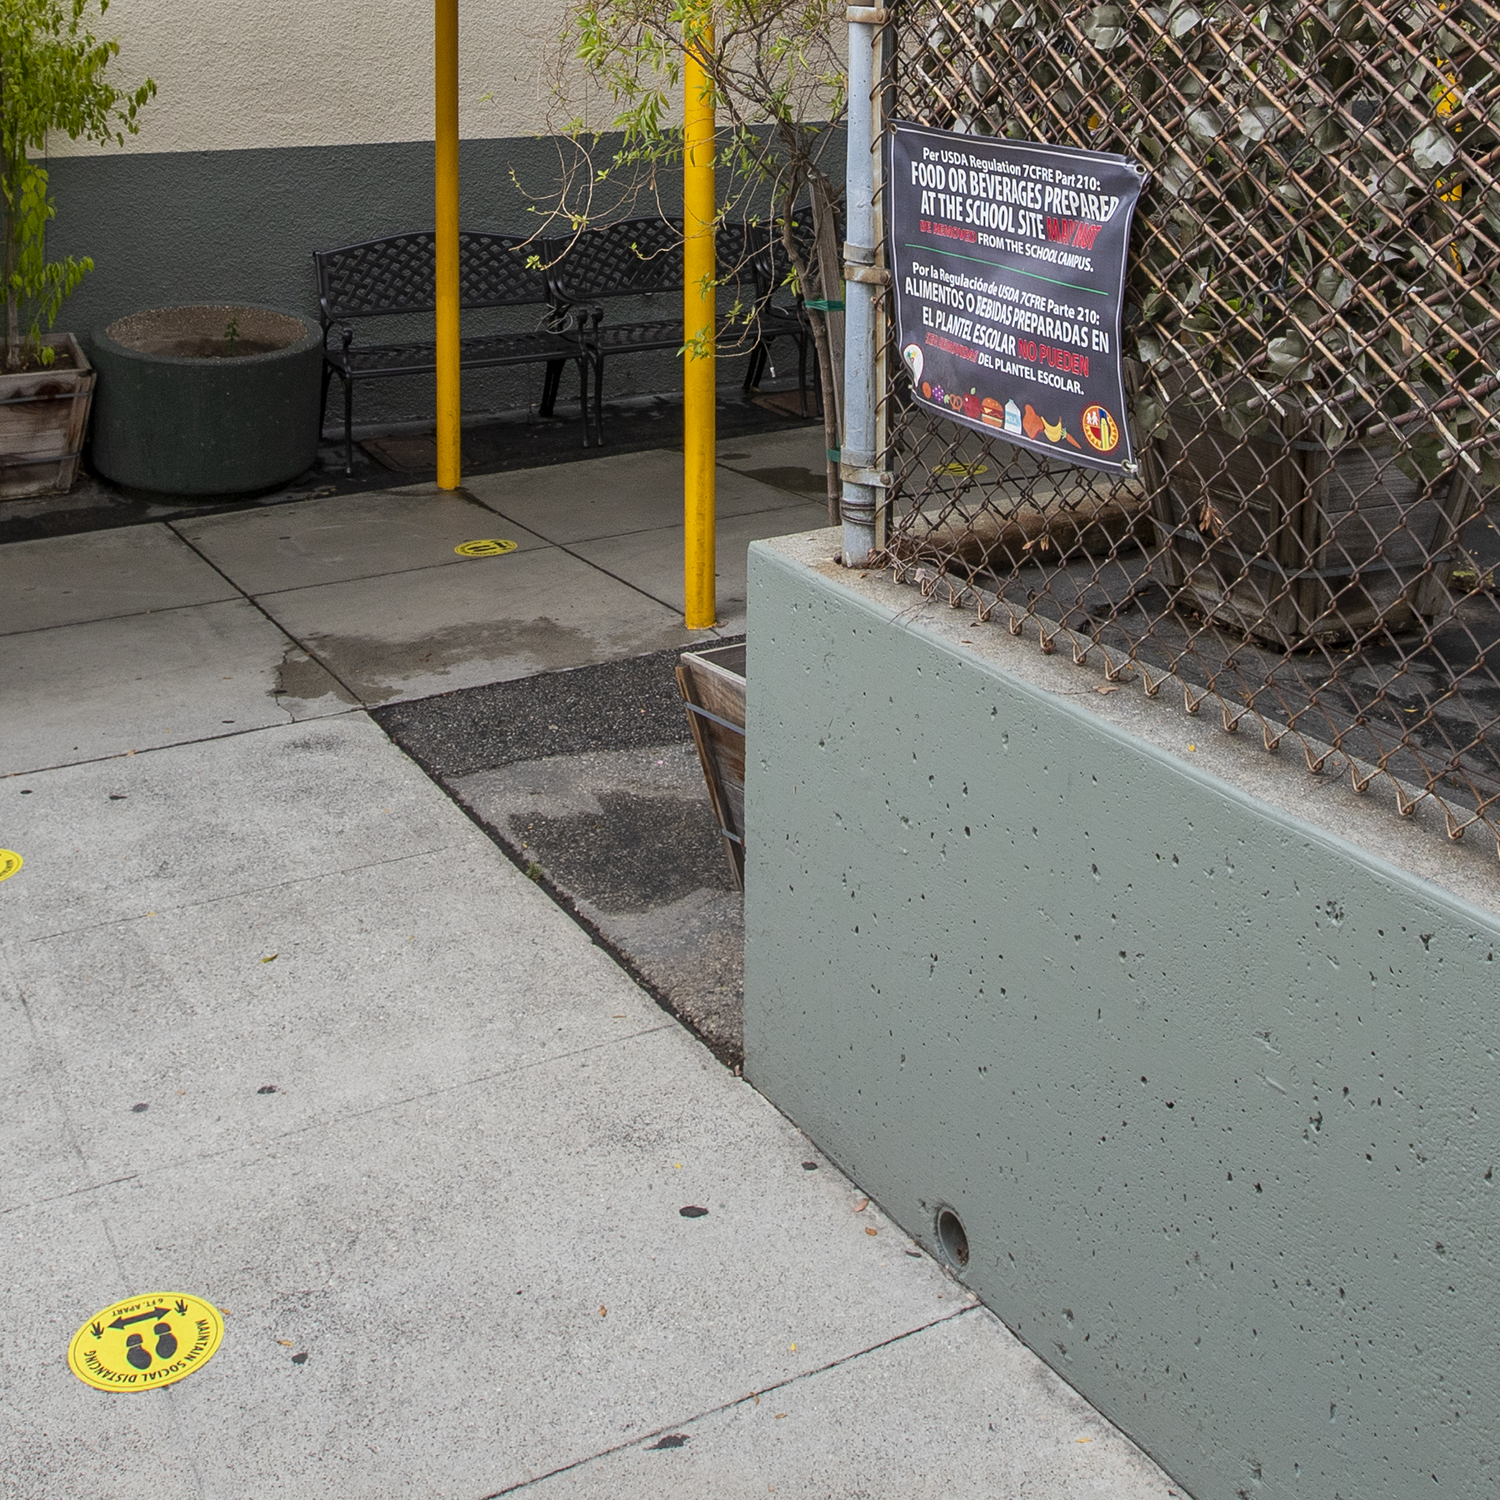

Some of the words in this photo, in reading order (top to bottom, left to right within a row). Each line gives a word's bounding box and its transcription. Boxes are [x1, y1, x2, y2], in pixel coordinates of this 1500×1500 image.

[911, 161, 946, 189] FOOD
[948, 168, 968, 193] OR
[970, 171, 1042, 209] BEVERAGES
[1044, 185, 1120, 222] PREPARED
[922, 147, 940, 161] Per
[940, 150, 969, 166] USDA
[969, 154, 1021, 176] Regulation
[1023, 165, 1054, 181] 7CFRE
[1056, 170, 1077, 187] Part
[1077, 175, 1102, 191] 210:
[920, 190, 937, 216] AT
[937, 192, 963, 221] THE
[965, 198, 1015, 232] SCHOOL
[1018, 209, 1046, 239] SITE
[1046, 215, 1078, 245] MAY
[919, 219, 933, 233] BE
[933, 222, 978, 243] REMOVED
[977, 232, 1005, 251] FROM
[1005, 238, 1025, 255] THE
[1025, 243, 1058, 264] SCHOOL
[1057, 250, 1094, 272] CAMPUS.
[905, 276, 965, 309] ALIMENTOS
[966, 294, 976, 312] O
[975, 295, 1012, 324] BEBIDAS
[1011, 306, 1089, 346] PREPARADAS
[1091, 327, 1110, 353] EN
[912, 262, 931, 276] Por
[930, 265, 939, 278] la
[939, 268, 989, 292] Regulación
[988, 280, 998, 295] de
[998, 284, 1021, 302] USDA
[1020, 291, 1046, 311] 7CFRE
[1047, 299, 1075, 319] Parte
[1076, 307, 1101, 325] 210:
[922, 306, 935, 326] EL
[935, 311, 973, 341] PLANTEL
[972, 323, 1017, 356] ESCOLAR
[1018, 338, 1037, 360] NO
[1039, 344, 1090, 377] PUEDEN
[977, 352, 994, 369] DEL
[994, 358, 1036, 381] PLANTEL
[1037, 373, 1085, 395] ESCOLAR.
[112, 1303, 141, 1318] APART
[184, 1318, 211, 1363] MAINTAIN
[83, 1349, 138, 1384] DISTANCING
[141, 1361, 187, 1383] SOCIAL
